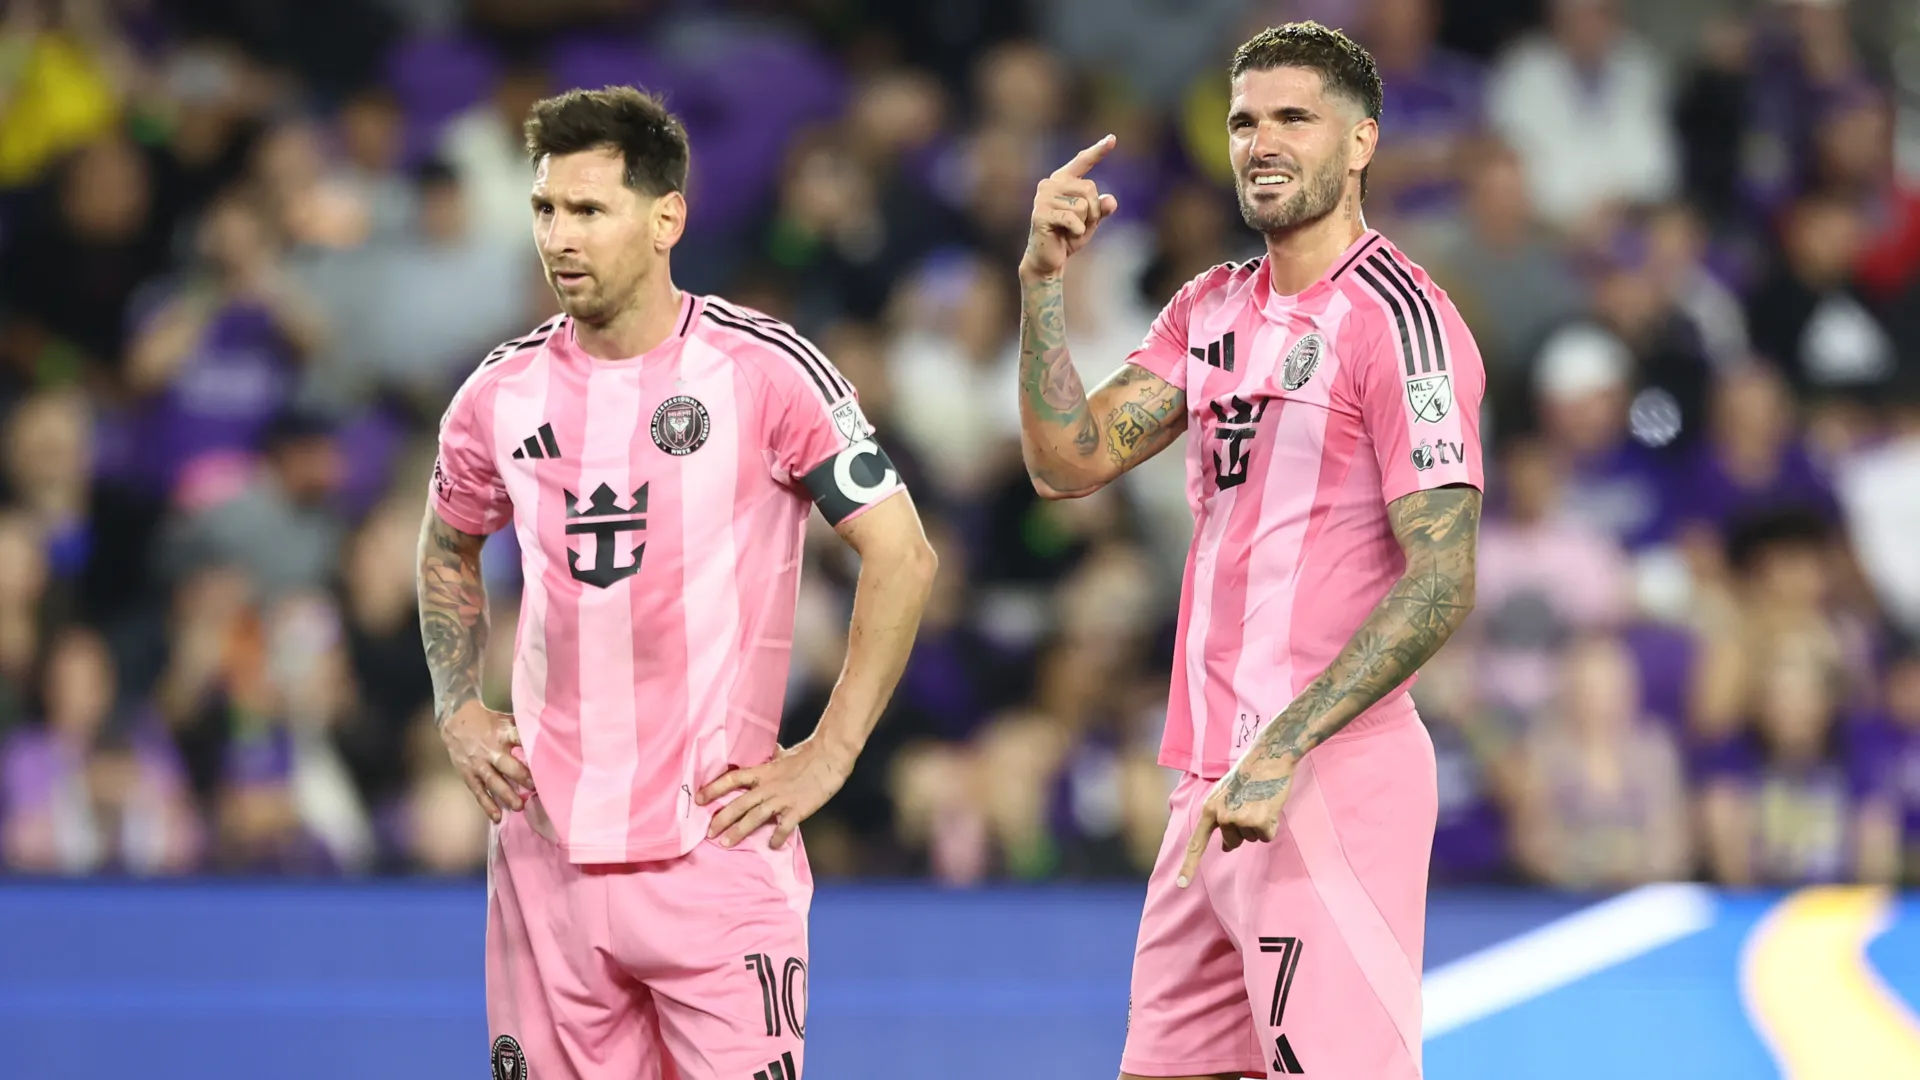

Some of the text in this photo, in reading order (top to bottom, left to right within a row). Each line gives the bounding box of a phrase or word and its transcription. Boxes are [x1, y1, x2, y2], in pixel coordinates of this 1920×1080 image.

[1410, 381, 1434, 393] MLS
[836, 406, 853, 420] MLS
[651, 427, 661, 444] CLUB
[1435, 439, 1464, 464] tv
[833, 439, 897, 504] C
[1258, 937, 1303, 1027] 7
[744, 953, 807, 1041] 10
